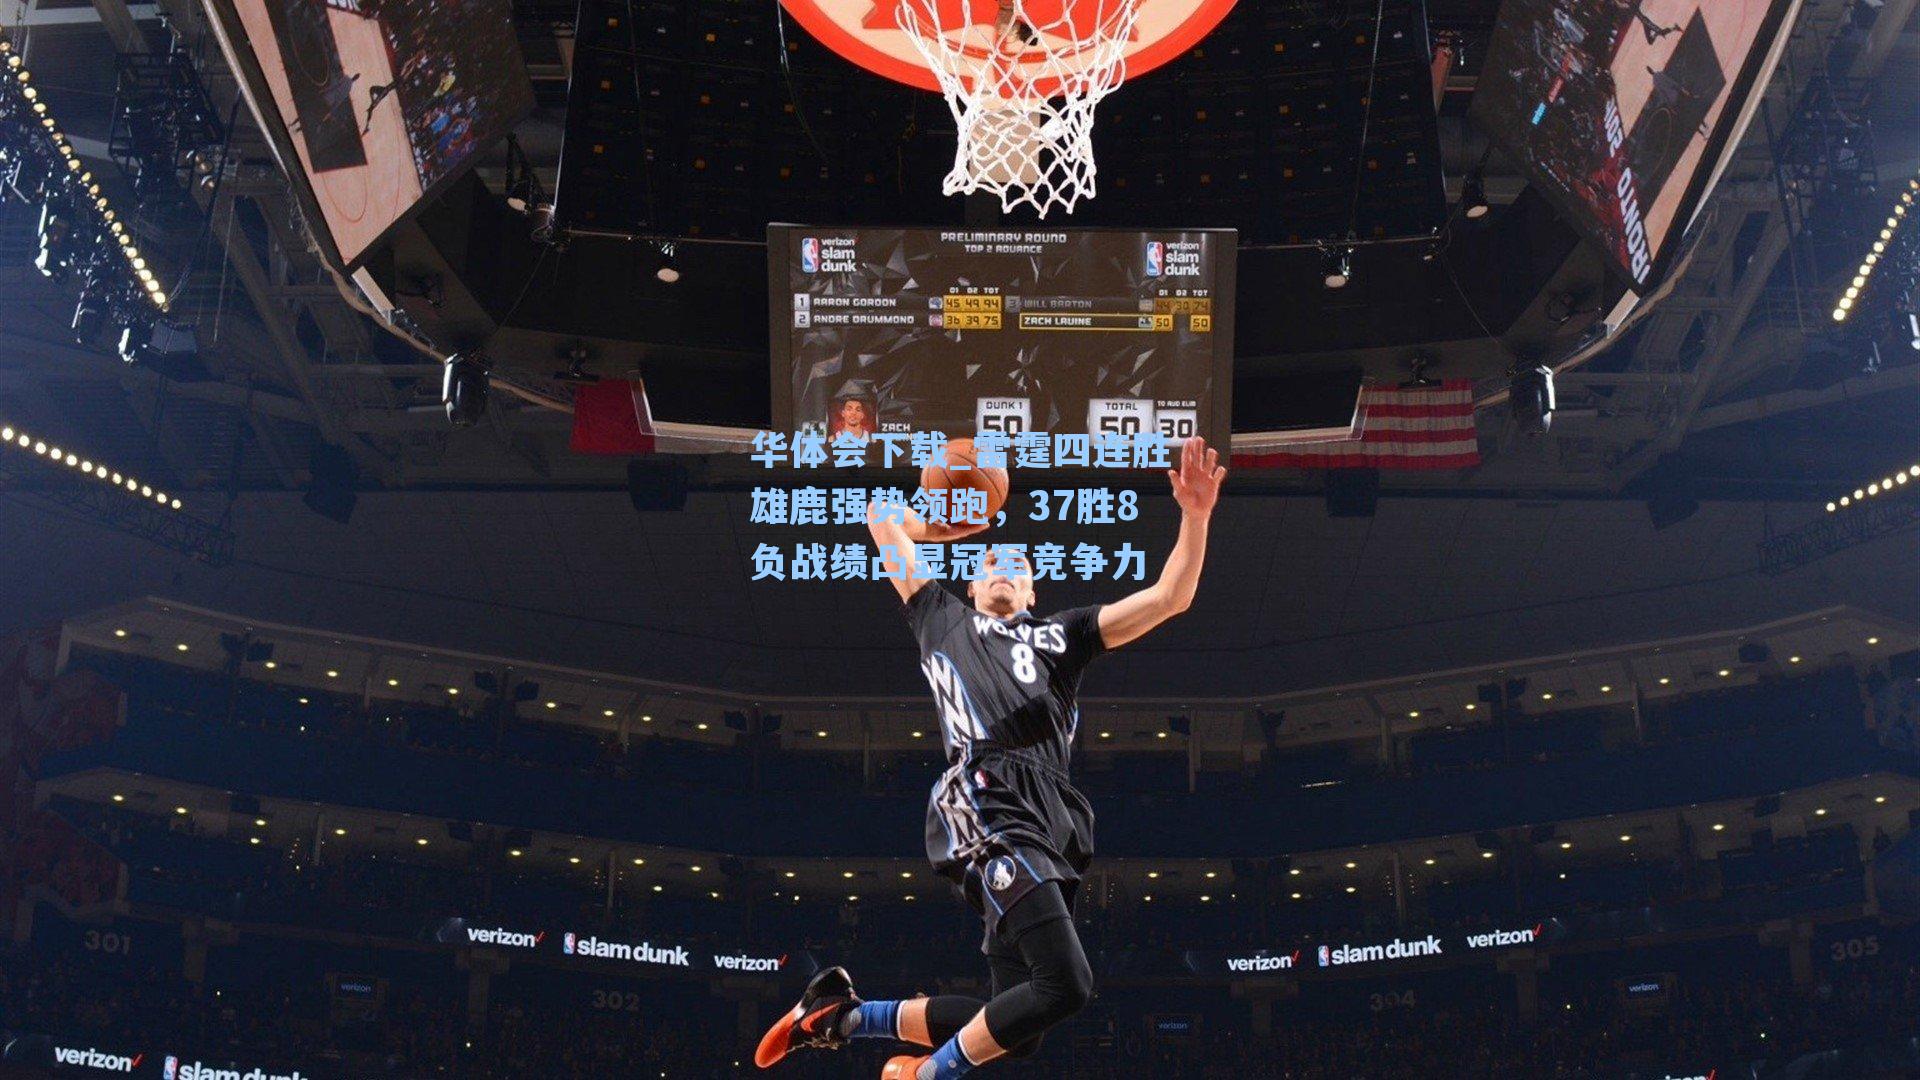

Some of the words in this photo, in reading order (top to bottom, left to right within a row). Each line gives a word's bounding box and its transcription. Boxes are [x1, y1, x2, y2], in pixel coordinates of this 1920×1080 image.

[821, 237, 855, 246] verizon
[941, 232, 1022, 243] PRELIMINARY
[1025, 233, 1067, 243] ROUND
[965, 244, 986, 253] TOP
[987, 245, 993, 253] 2
[995, 245, 1043, 254] ADVANCE
[1166, 242, 1199, 250] verizon
[821, 247, 855, 259] slam
[1165, 251, 1199, 263] slam
[821, 260, 857, 272] dunk
[1165, 263, 1200, 276] dunk
[800, 298, 805, 307] 1
[813, 298, 850, 307] AARON
[853, 298, 896, 307] GORDON
[946, 299, 960, 308] 45
[965, 299, 979, 308] 49
[984, 299, 999, 308] 94
[1024, 300, 1047, 308] WILL
[1050, 300, 1092, 308] BARTON
[798, 315, 806, 324] 2
[814, 315, 849, 324] ANDRE
[852, 315, 914, 324] DRUMMOND
[966, 316, 980, 325] 39
[984, 316, 998, 325] 75
[1024, 317, 1052, 325] ZACH
[1055, 317, 1092, 326] LAVINE
[1156, 317, 1170, 327] 50
[1193, 317, 1208, 327] 50
[986, 401, 1015, 410] DUNK
[1019, 401, 1023, 410] 1
[1106, 402, 1138, 411] TOTAL
[881, 423, 911, 433] ZACH
[1160, 418, 1193, 438] 30
[973, 615, 1066, 654] WOLVES
[1010, 642, 1041, 684] 8
[86, 930, 131, 955] 301
[467, 928, 536, 948] verizon
[1467, 929, 1534, 948] verizon
[577, 936, 631, 960] slam
[632, 942, 690, 966] dunk
[1331, 944, 1384, 965] slam
[1385, 935, 1442, 959] dunk
[1831, 936, 1879, 961] 305
[714, 954, 779, 971] verizon
[1227, 955, 1292, 971] verizon
[340, 982, 373, 994] verizon
[1628, 983, 1659, 992] verizon
[592, 990, 640, 1011] 302
[55, 1047, 132, 1072] verizon
